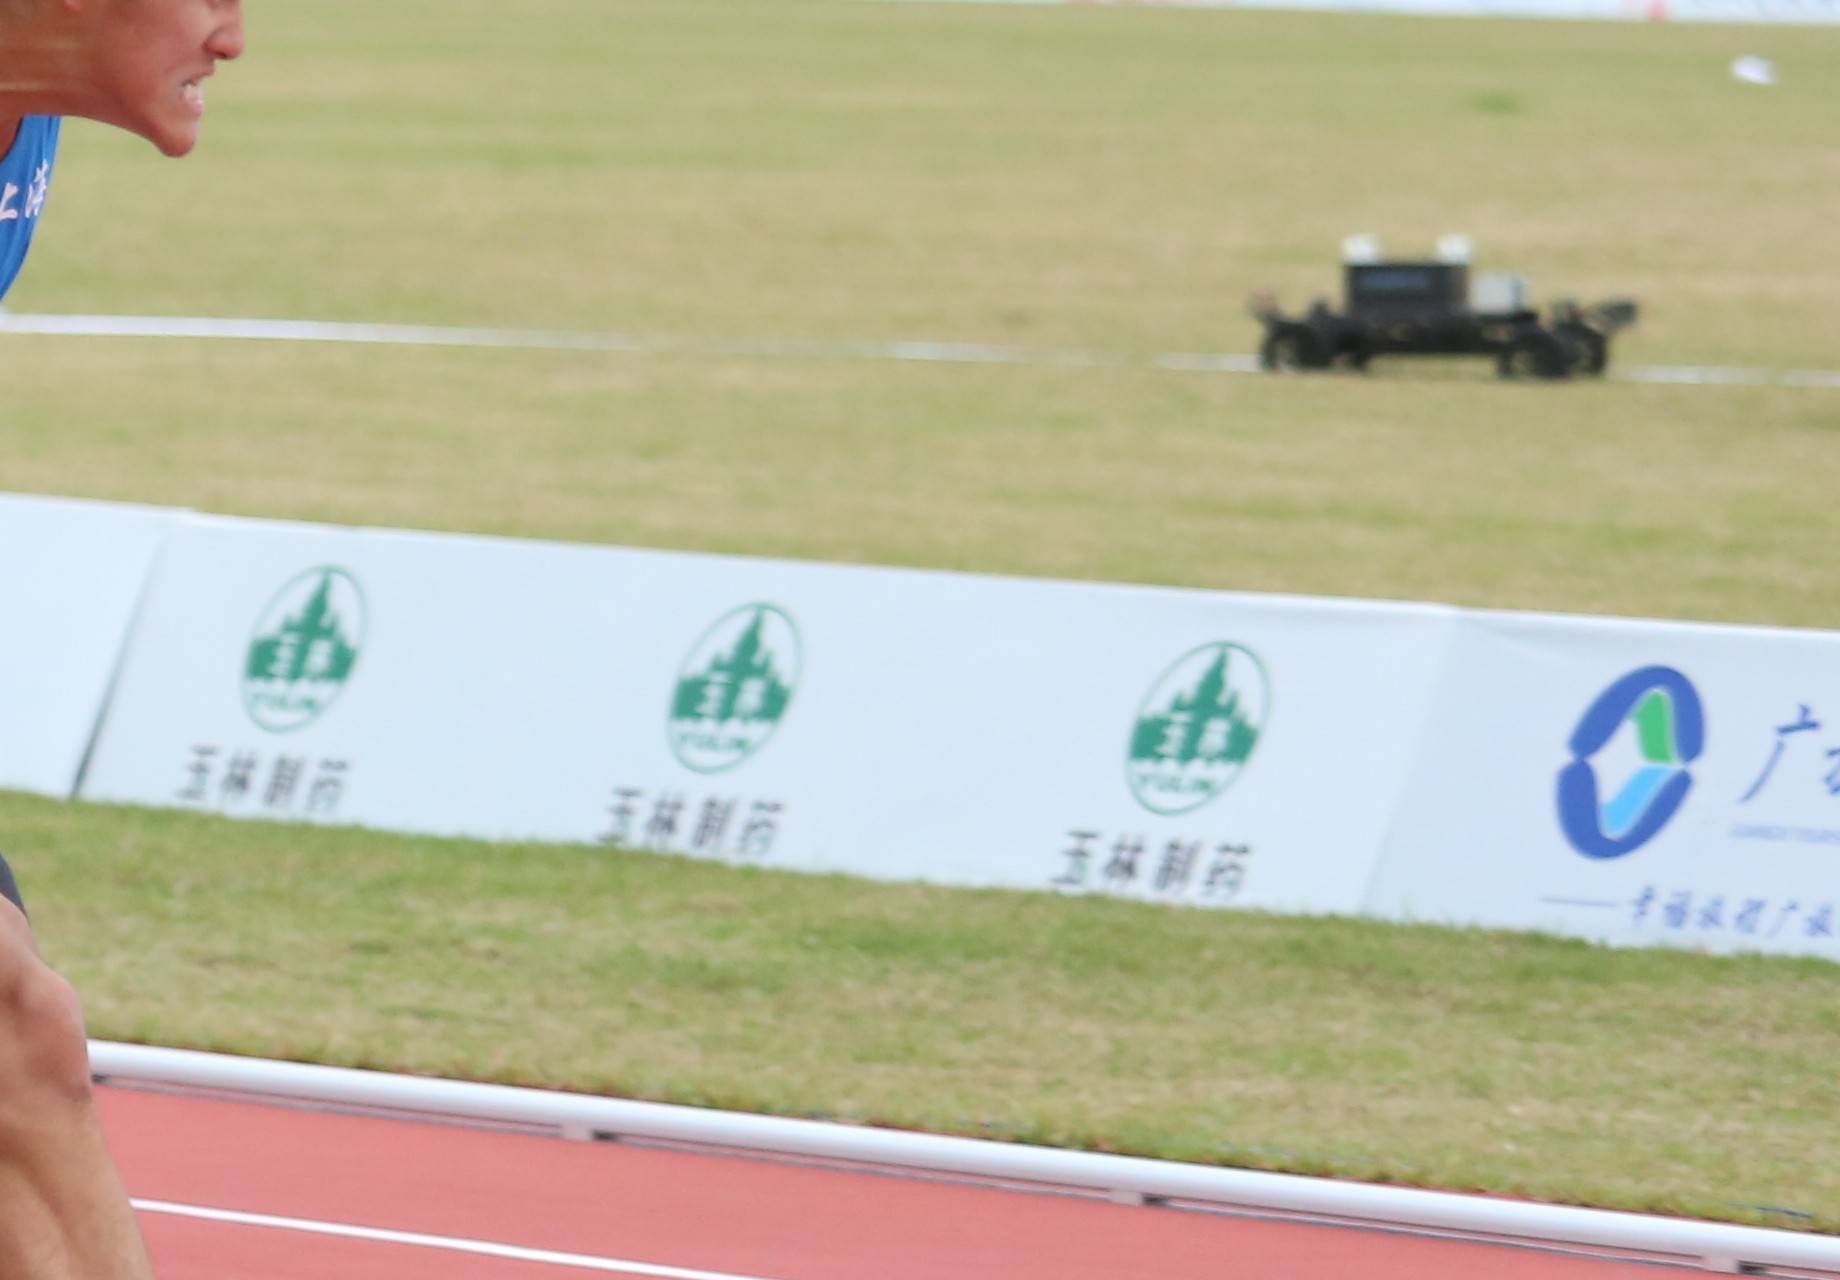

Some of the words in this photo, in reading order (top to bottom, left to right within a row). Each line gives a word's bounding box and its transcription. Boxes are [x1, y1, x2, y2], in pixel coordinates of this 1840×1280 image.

[174, 744, 350, 811] 玉林制药
[597, 787, 784, 855] 玉林制药
[1049, 829, 1253, 898] 玉林制药
